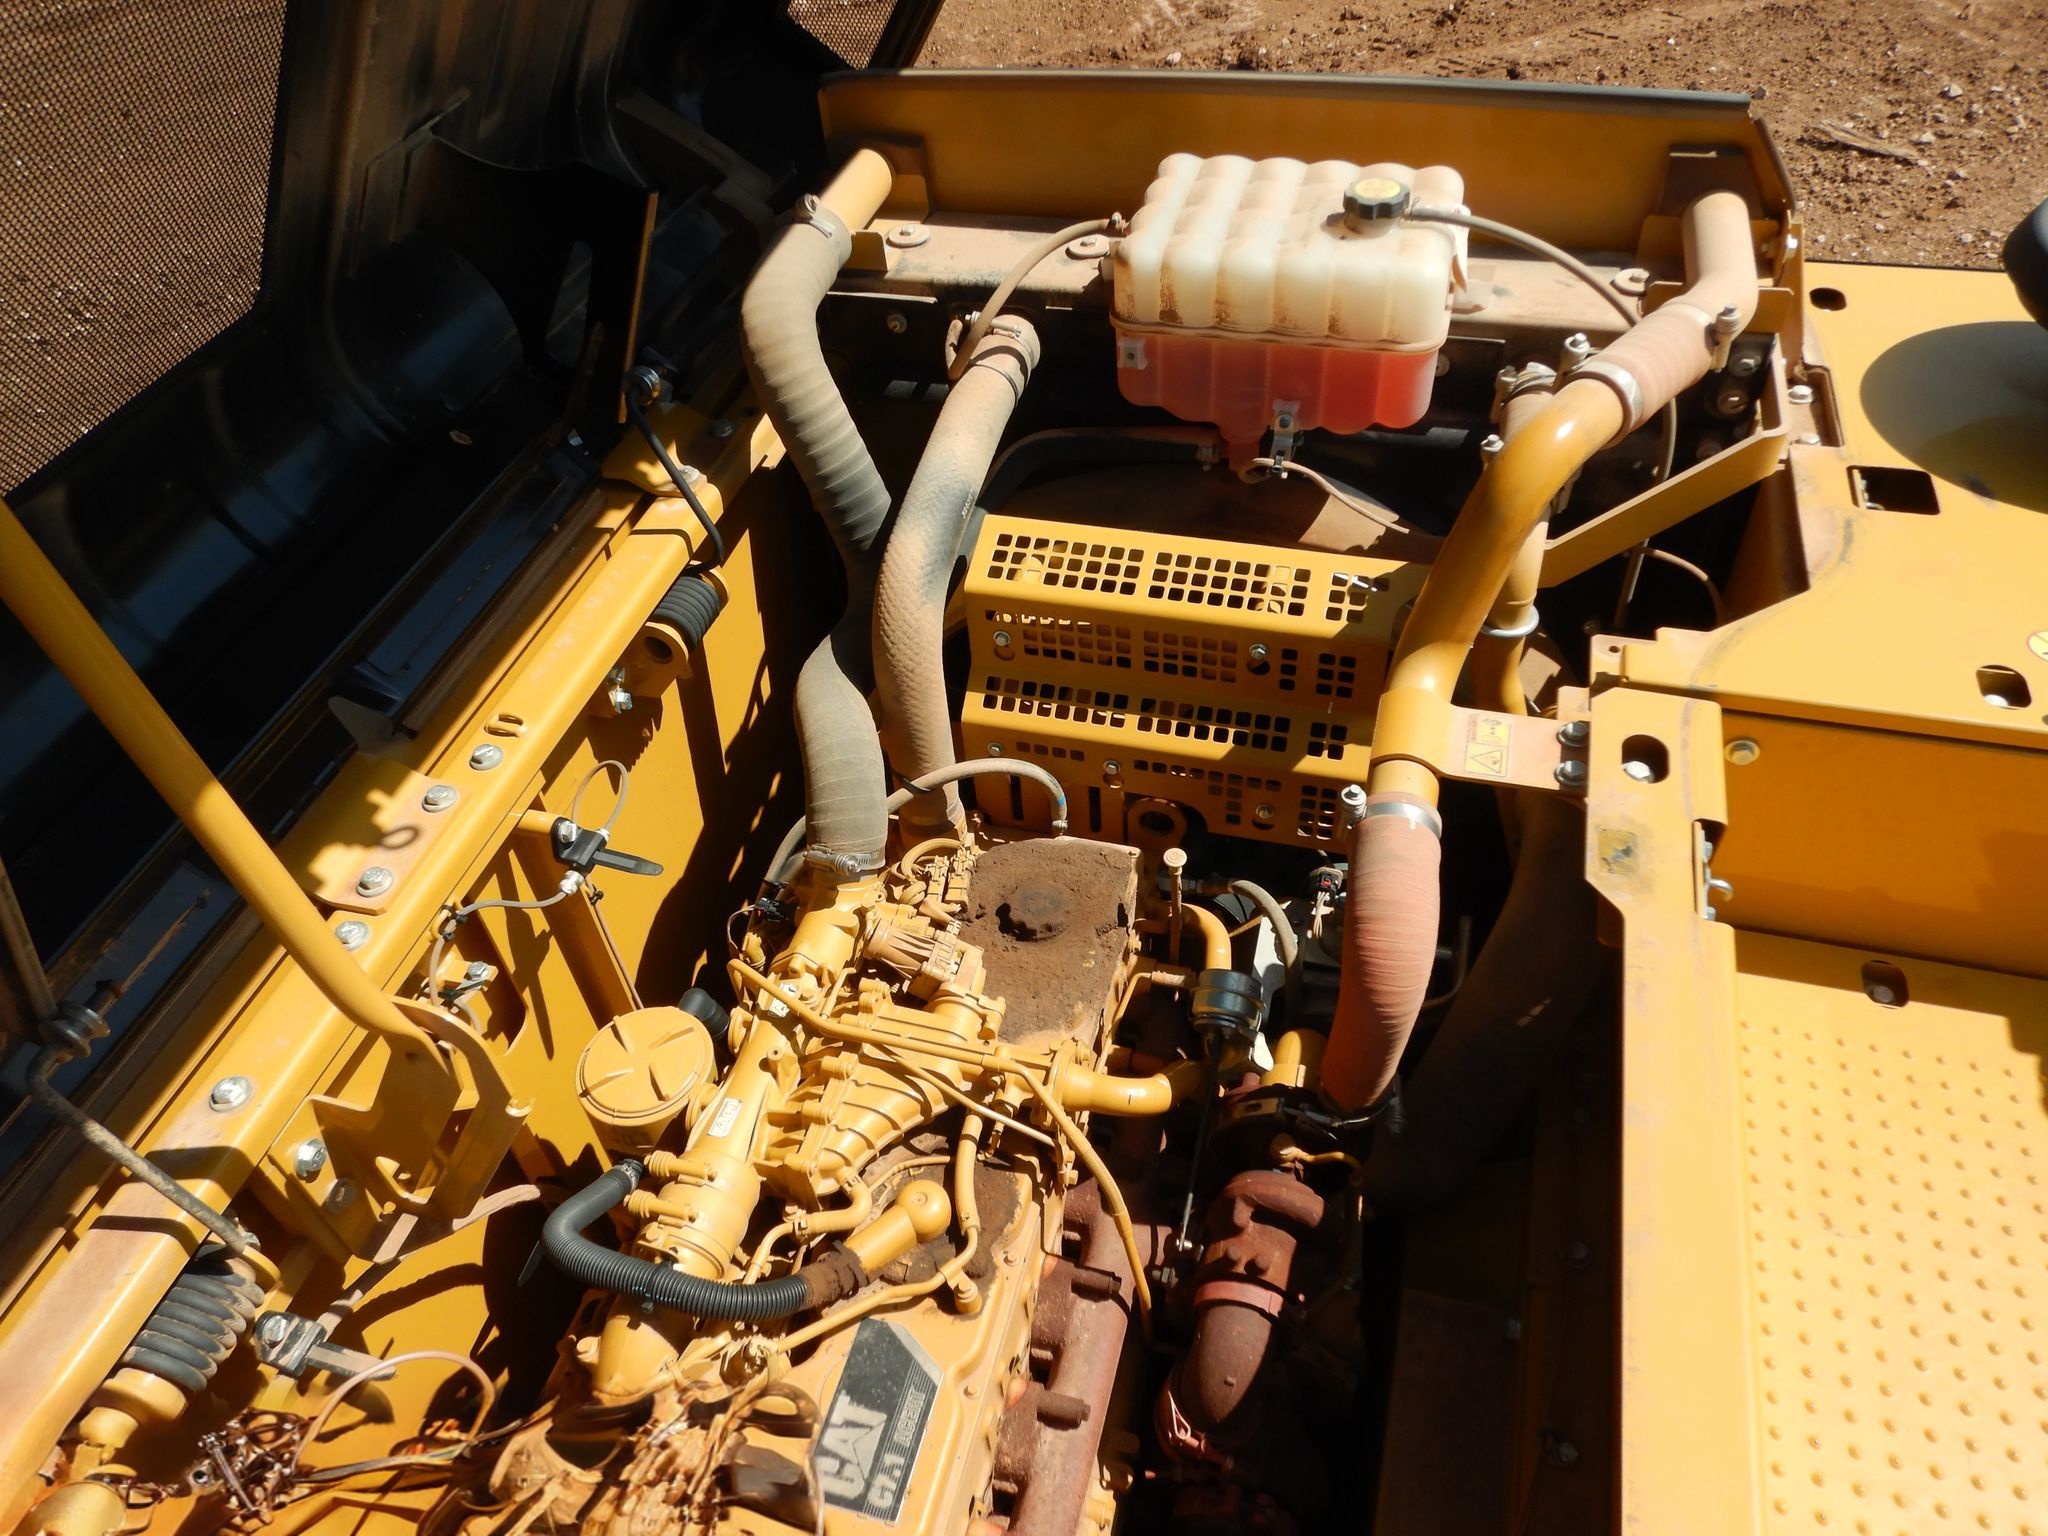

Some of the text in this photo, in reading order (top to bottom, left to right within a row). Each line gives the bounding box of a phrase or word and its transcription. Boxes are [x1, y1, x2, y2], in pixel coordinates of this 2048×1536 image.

[815, 1389, 887, 1499] CAT
[868, 1386, 926, 1508] C7.1 ACERT
